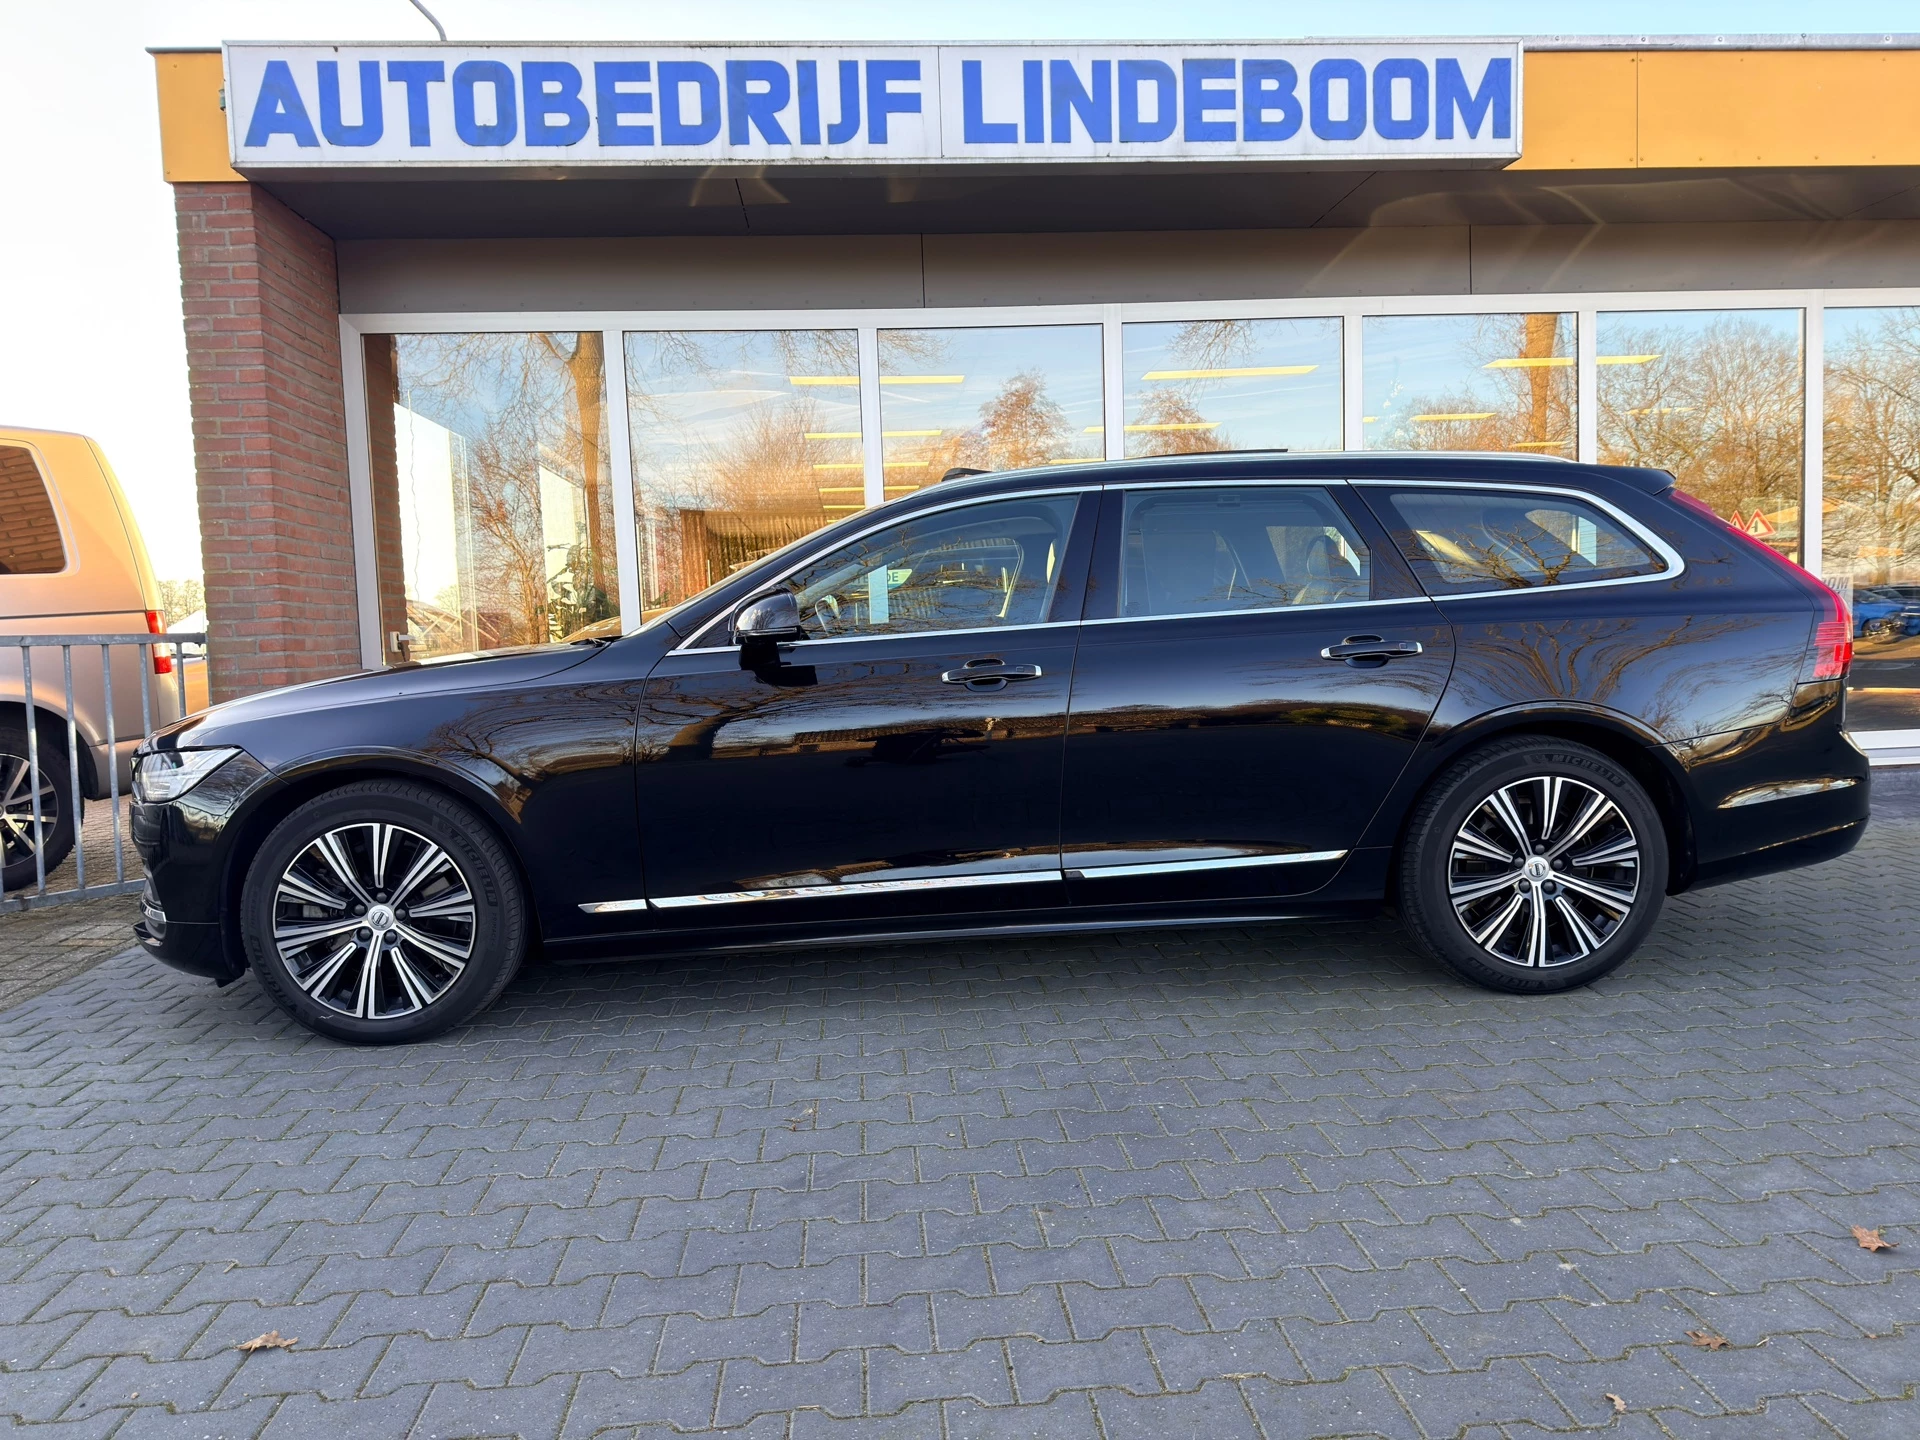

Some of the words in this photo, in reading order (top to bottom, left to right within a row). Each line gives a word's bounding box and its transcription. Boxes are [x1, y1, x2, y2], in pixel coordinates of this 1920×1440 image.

[247, 61, 921, 146] AUTOBEDRIJF
[963, 59, 1511, 143] LINDEBOOM
[1551, 754, 1622, 786] MICHELIN
[452, 834, 498, 904] MICHELIN
